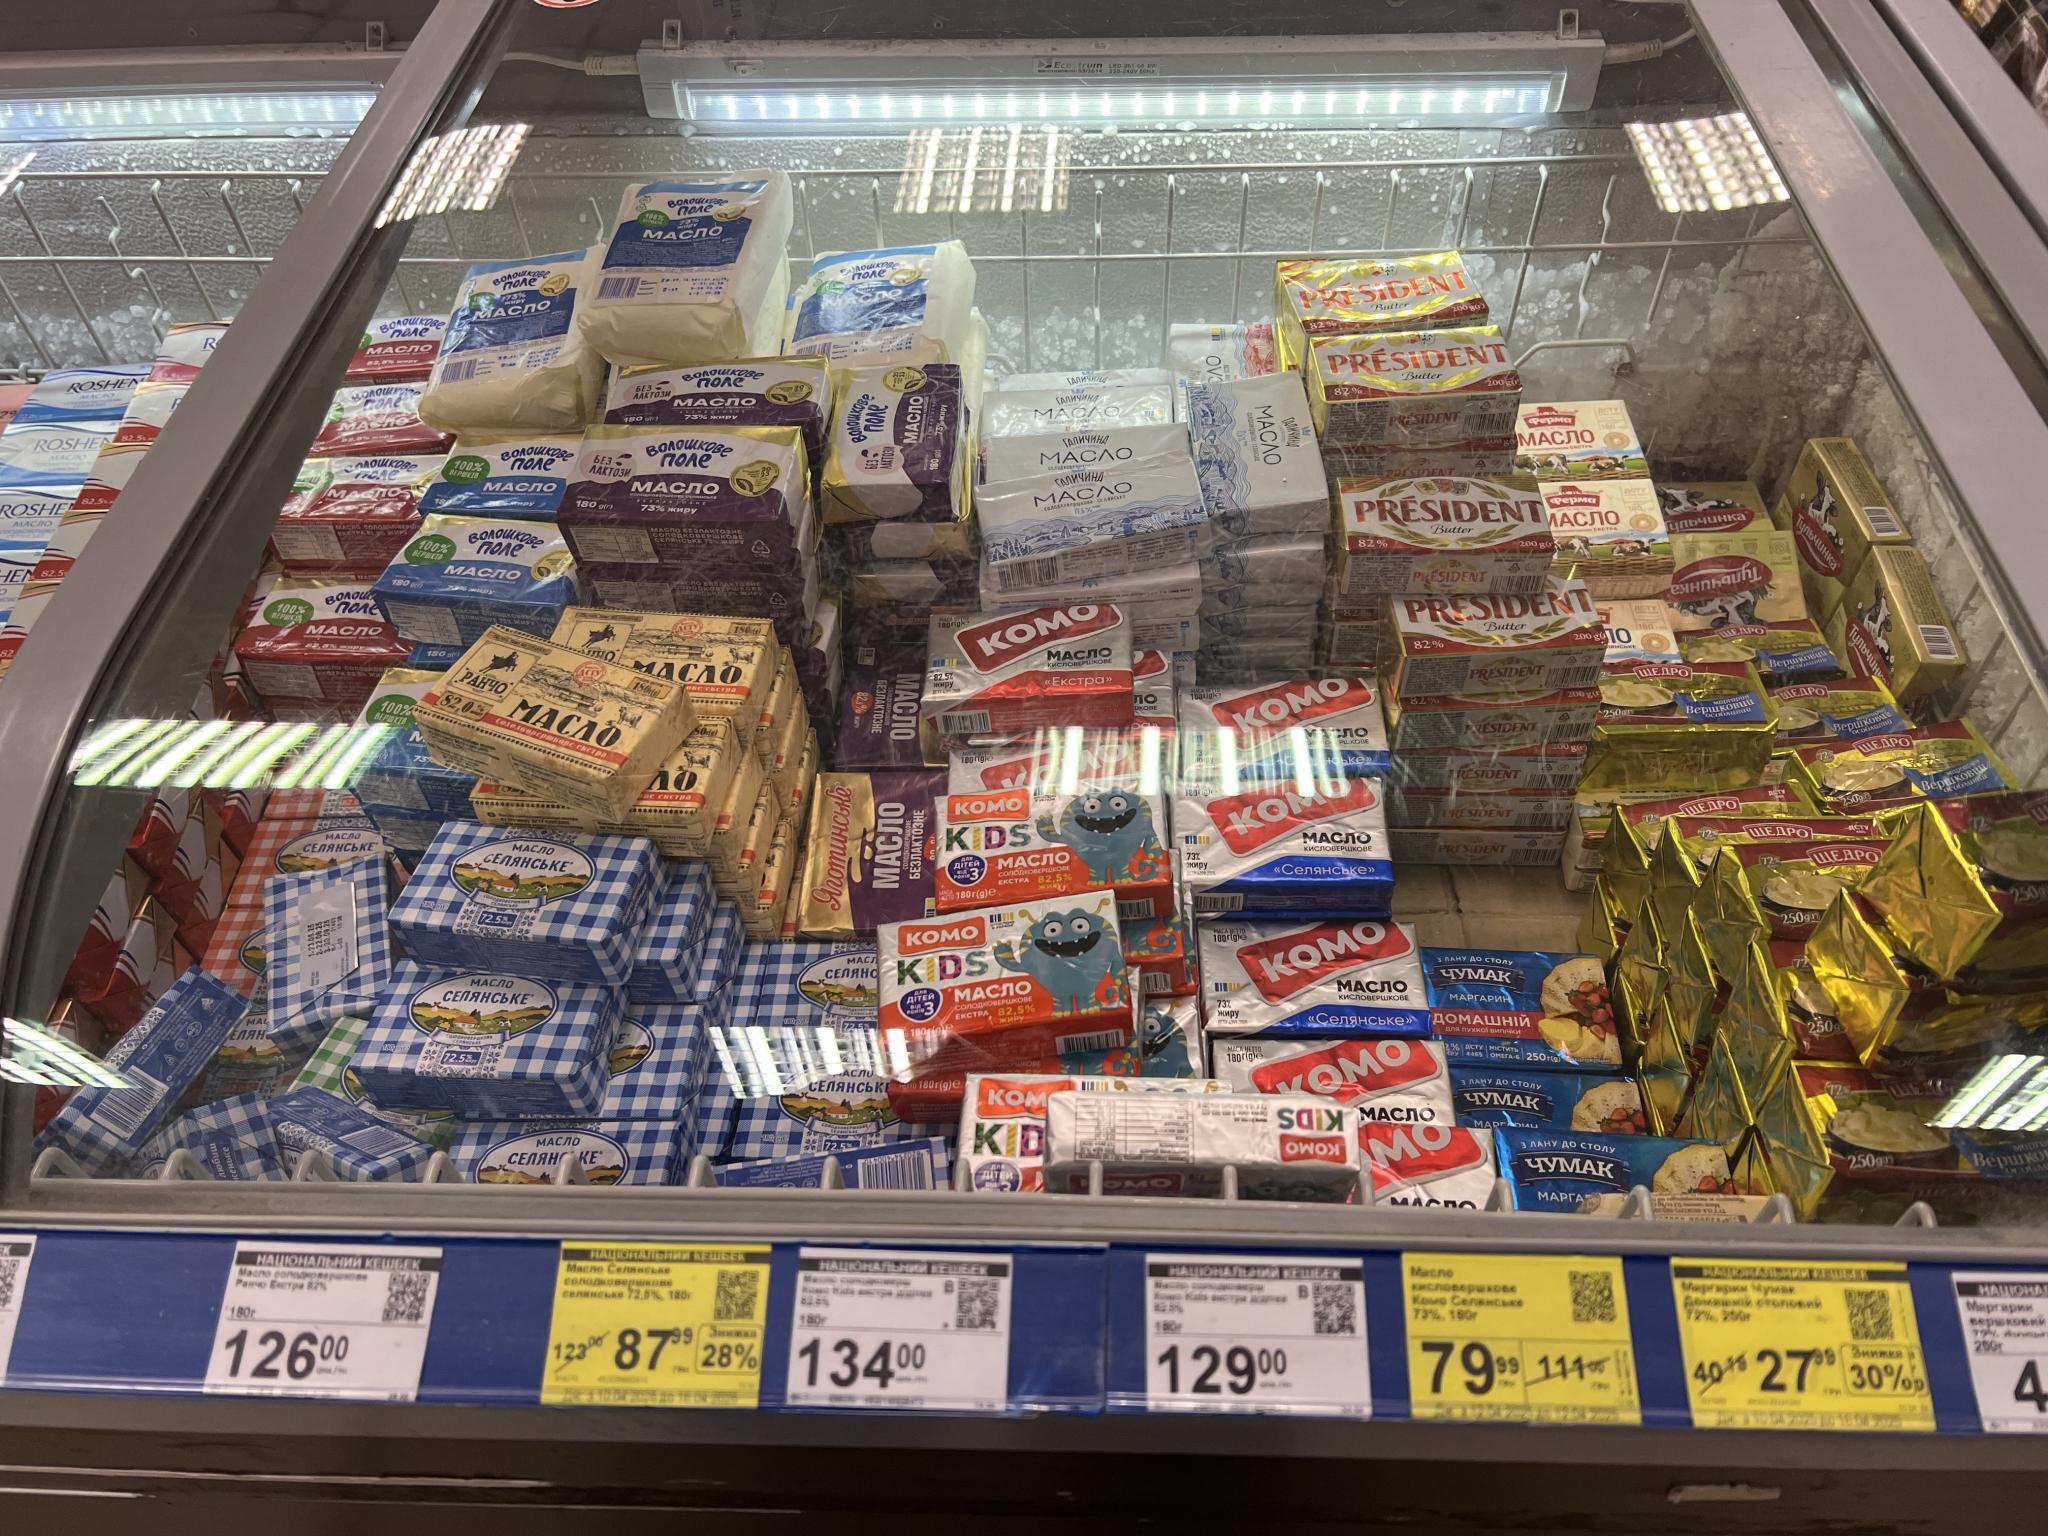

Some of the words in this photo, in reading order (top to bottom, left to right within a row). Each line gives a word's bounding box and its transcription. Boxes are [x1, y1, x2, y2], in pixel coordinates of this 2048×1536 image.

[642, 226, 723, 240] МАСЛО
[1298, 270, 1468, 310] PRÉSIDENT
[1372, 301, 1410, 312] Butter
[1327, 343, 1508, 376] PRÉSIDENT
[1401, 371, 1443, 381] Butter
[673, 397, 757, 408] МАСЛО
[903, 395, 924, 445] МАСЛО
[1527, 415, 1573, 428] Ферма
[1062, 434, 1110, 448] ГАЛИЧИНА
[1254, 404, 1282, 466] МАСЛО
[1517, 429, 1595, 447] МАСЛО
[592, 454, 613, 466] БЕЗ
[864, 456, 879, 470] БЕЗ
[1039, 447, 1133, 466] МАСЛО
[588, 463, 632, 478] ЛАКТОЗИ
[482, 482, 558, 493] МАСЛО
[630, 480, 720, 495] МАСЛО
[1033, 482, 1133, 508] МАСЛО
[575, 499, 598, 509] 180
[1550, 495, 1597, 506] Ферма
[641, 504, 666, 513] 73%
[667, 504, 698, 515] жиру
[1353, 495, 1544, 527] PRÉSIDENT
[1430, 523, 1475, 535] Butter
[1518, 539, 1538, 548] 200
[1795, 513, 1838, 571] Тульчинка
[443, 565, 522, 580] МАСЛО
[1411, 570, 1489, 585] PRÉSIDENT
[1670, 561, 1762, 595] Тульчинка
[305, 625, 383, 636] МАСЛО
[976, 604, 1099, 657] КОМО
[1482, 620, 1527, 633] Butter
[1571, 632, 1593, 642] 200
[1046, 647, 1112, 662] МАСЛО
[1468, 663, 1545, 681] PRÉSIDENT
[1638, 666, 1690, 678] ЩЕДРО
[458, 669, 509, 696] РАНЧО
[1044, 675, 1112, 688] «Екстра»
[1780, 686, 1826, 699] ЩЕДРО
[871, 679, 888, 735] БЕЗЛАКТОЗНЕ
[889, 672, 922, 742] МАСЛО
[1602, 709, 1622, 718] 250
[1685, 698, 1755, 716] Вершковий
[507, 699, 623, 748] МАСЛО
[1832, 711, 1892, 733] Вершковий
[1857, 737, 1911, 754] ЩЕДРО
[1920, 763, 1989, 791] Вершковий
[954, 797, 1024, 815] КОМО
[1684, 800, 1738, 815] ЩЕДРО
[945, 823, 1032, 851] KIDS
[1302, 831, 1372, 844] МАСЛО
[1749, 825, 1809, 838] ЩЕДРО
[302, 842, 376, 853] СЕЛЯНСЬКЕ
[511, 843, 556, 856] МАСЛО
[810, 785, 852, 912] Яготинське
[871, 802, 905, 890] МАСЛО
[908, 809, 925, 880] БЕЗЛАКТОЗНЕ
[482, 853, 570, 873] СЕЛЯНСЬКЕ
[997, 851, 1071, 870] МАСЛО
[1814, 848, 1880, 865] ЩЕДРО
[1273, 863, 1376, 876] «Селянське»
[1781, 912, 1804, 924] 250
[904, 925, 980, 947] КОМО
[1257, 922, 1386, 983] КОМО
[896, 951, 990, 986] KIDS
[1439, 967, 1512, 983] ЧУМАК
[470, 978, 515, 989] МАСЛО
[1336, 980, 1408, 993] МАСЛО
[442, 991, 531, 1006] СЕЛЯНСЬКЕ
[906, 993, 935, 1005] ДІТЕЙ
[953, 980, 1032, 1003] МАСЛО
[1338, 994, 1409, 1002] КИСЛОВЕРШКОВЕ
[1449, 993, 1511, 1004] МАРГАРИН
[923, 1001, 935, 1016] 3
[955, 1011, 989, 1020] ЕКСТРА
[1216, 1009, 1240, 1019] жиру
[1307, 1012, 1413, 1027] «Селянське»
[1432, 1011, 1531, 1028] ДОМАШНІЙ
[1495, 1078, 1509, 1086] ДО
[1511, 1079, 1542, 1091] СТОЛУ
[1464, 1089, 1539, 1110] ЧУМАК
[1278, 1107, 1344, 1132] KIDS
[1358, 1106, 1436, 1121] МАСЛО
[535, 1137, 581, 1148] МАСЛО
[1285, 1140, 1340, 1156] КОМО
[1530, 1139, 1558, 1148] ЛАНУ
[1561, 1140, 1577, 1149] ДО
[1580, 1141, 1616, 1153] СТОЛУ
[1524, 1156, 1614, 1179] ЧУМАК
[1847, 1154, 1876, 1169] 250
[257, 1254, 361, 1268] НАЦІОНАЛЬНИЙ
[224, 1329, 319, 1381] 126
[320, 1335, 350, 1361] 00
[614, 1328, 672, 1372] 87
[671, 1327, 694, 1345] 99
[701, 1344, 758, 1370] 28%
[799, 1337, 895, 1389] 134
[897, 1343, 926, 1370] 00
[1157, 1344, 1256, 1395] 129
[1258, 1348, 1287, 1375] 00
[1421, 1341, 1495, 1396] 79
[1496, 1357, 1520, 1375] 99
[1756, 1349, 1815, 1393] 27
